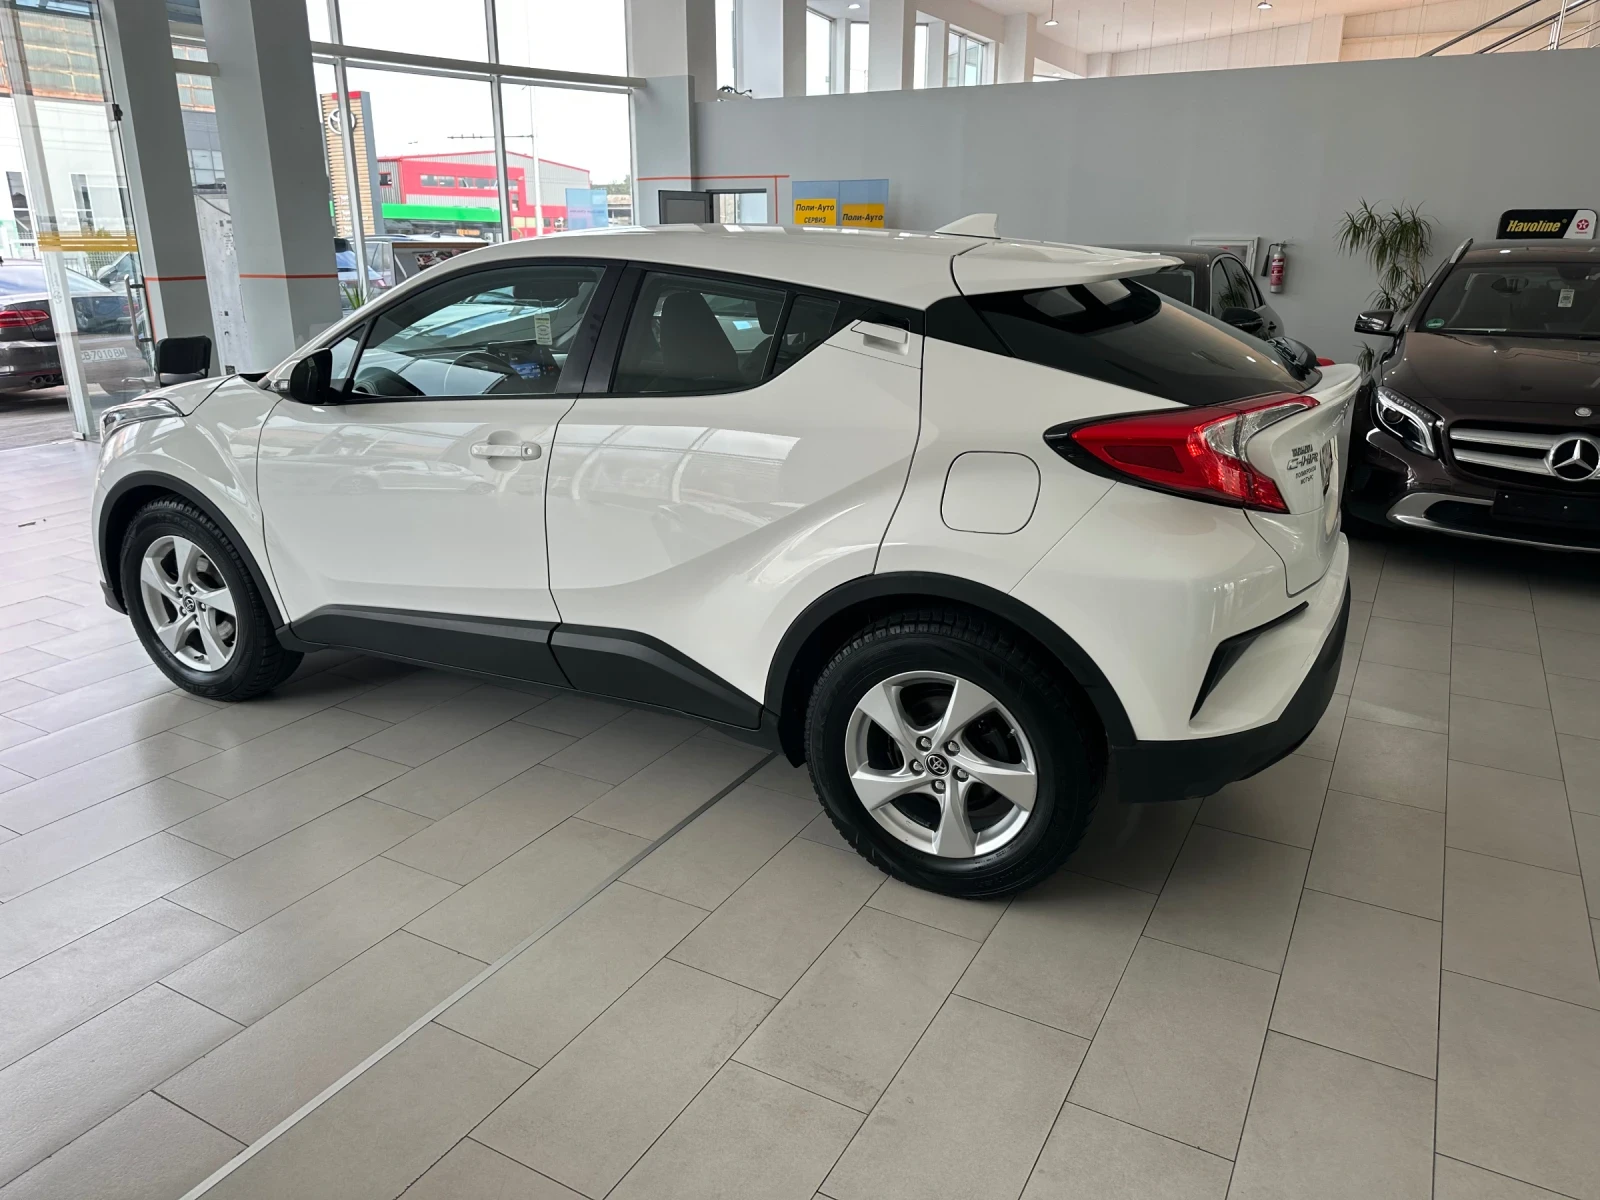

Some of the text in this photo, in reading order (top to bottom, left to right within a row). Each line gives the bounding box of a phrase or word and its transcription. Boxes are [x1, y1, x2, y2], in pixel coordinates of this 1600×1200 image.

[795, 203, 835, 213] Поли-Ауто
[803, 216, 827, 224] СЕРВИЗ
[842, 213, 884, 223] Поли-Ауто
[1506, 220, 1561, 233] Havoline
